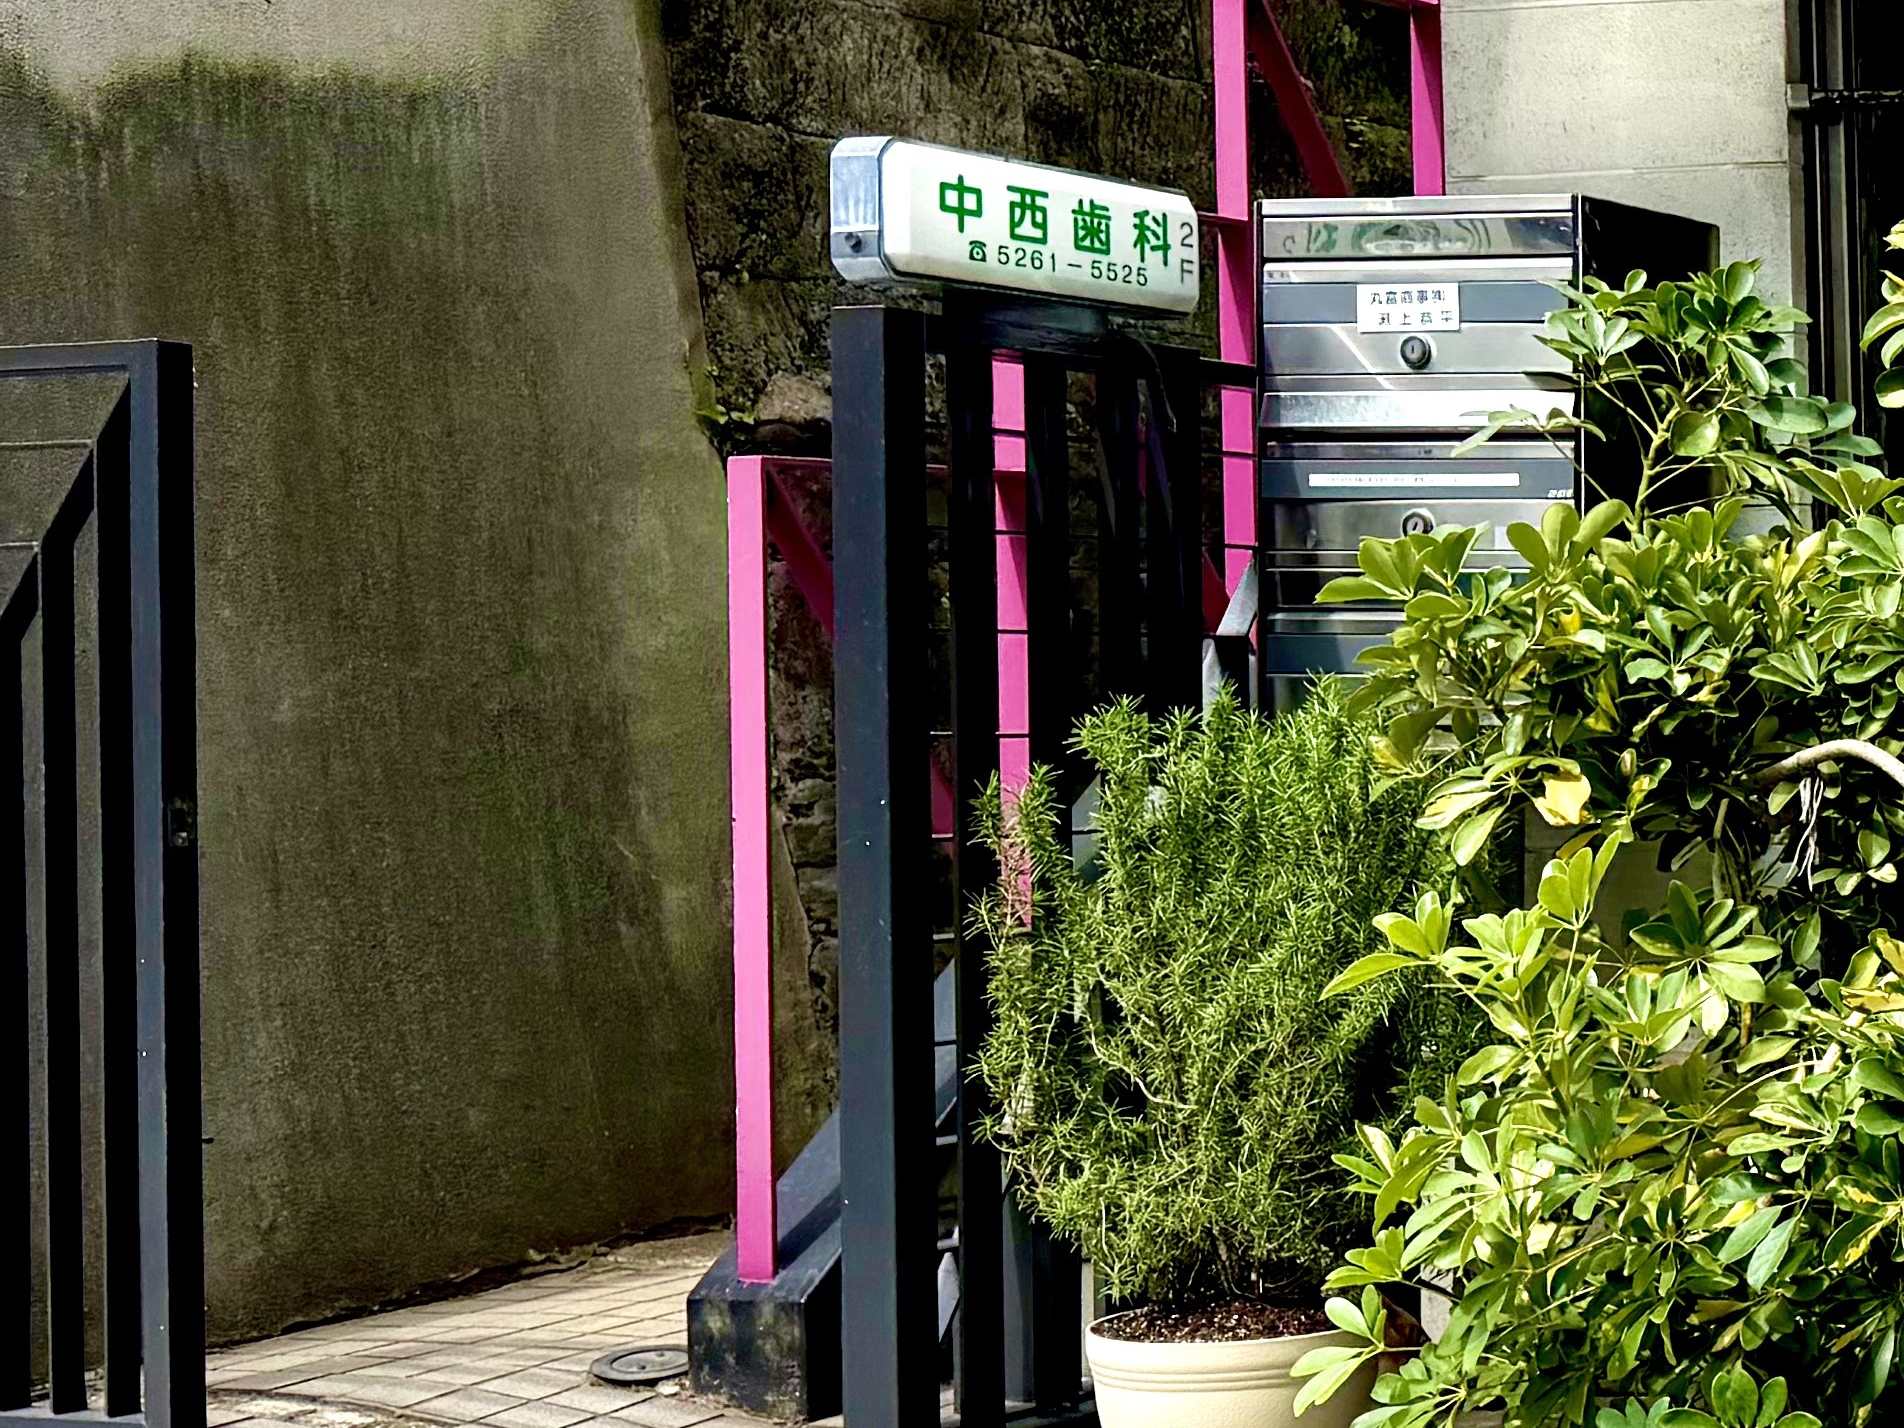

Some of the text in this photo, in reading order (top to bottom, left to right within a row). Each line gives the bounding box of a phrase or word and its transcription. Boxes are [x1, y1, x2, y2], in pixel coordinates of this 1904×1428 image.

[939, 174, 1172, 267] 中西歯科
[997, 245, 1149, 286] 5261-5525
